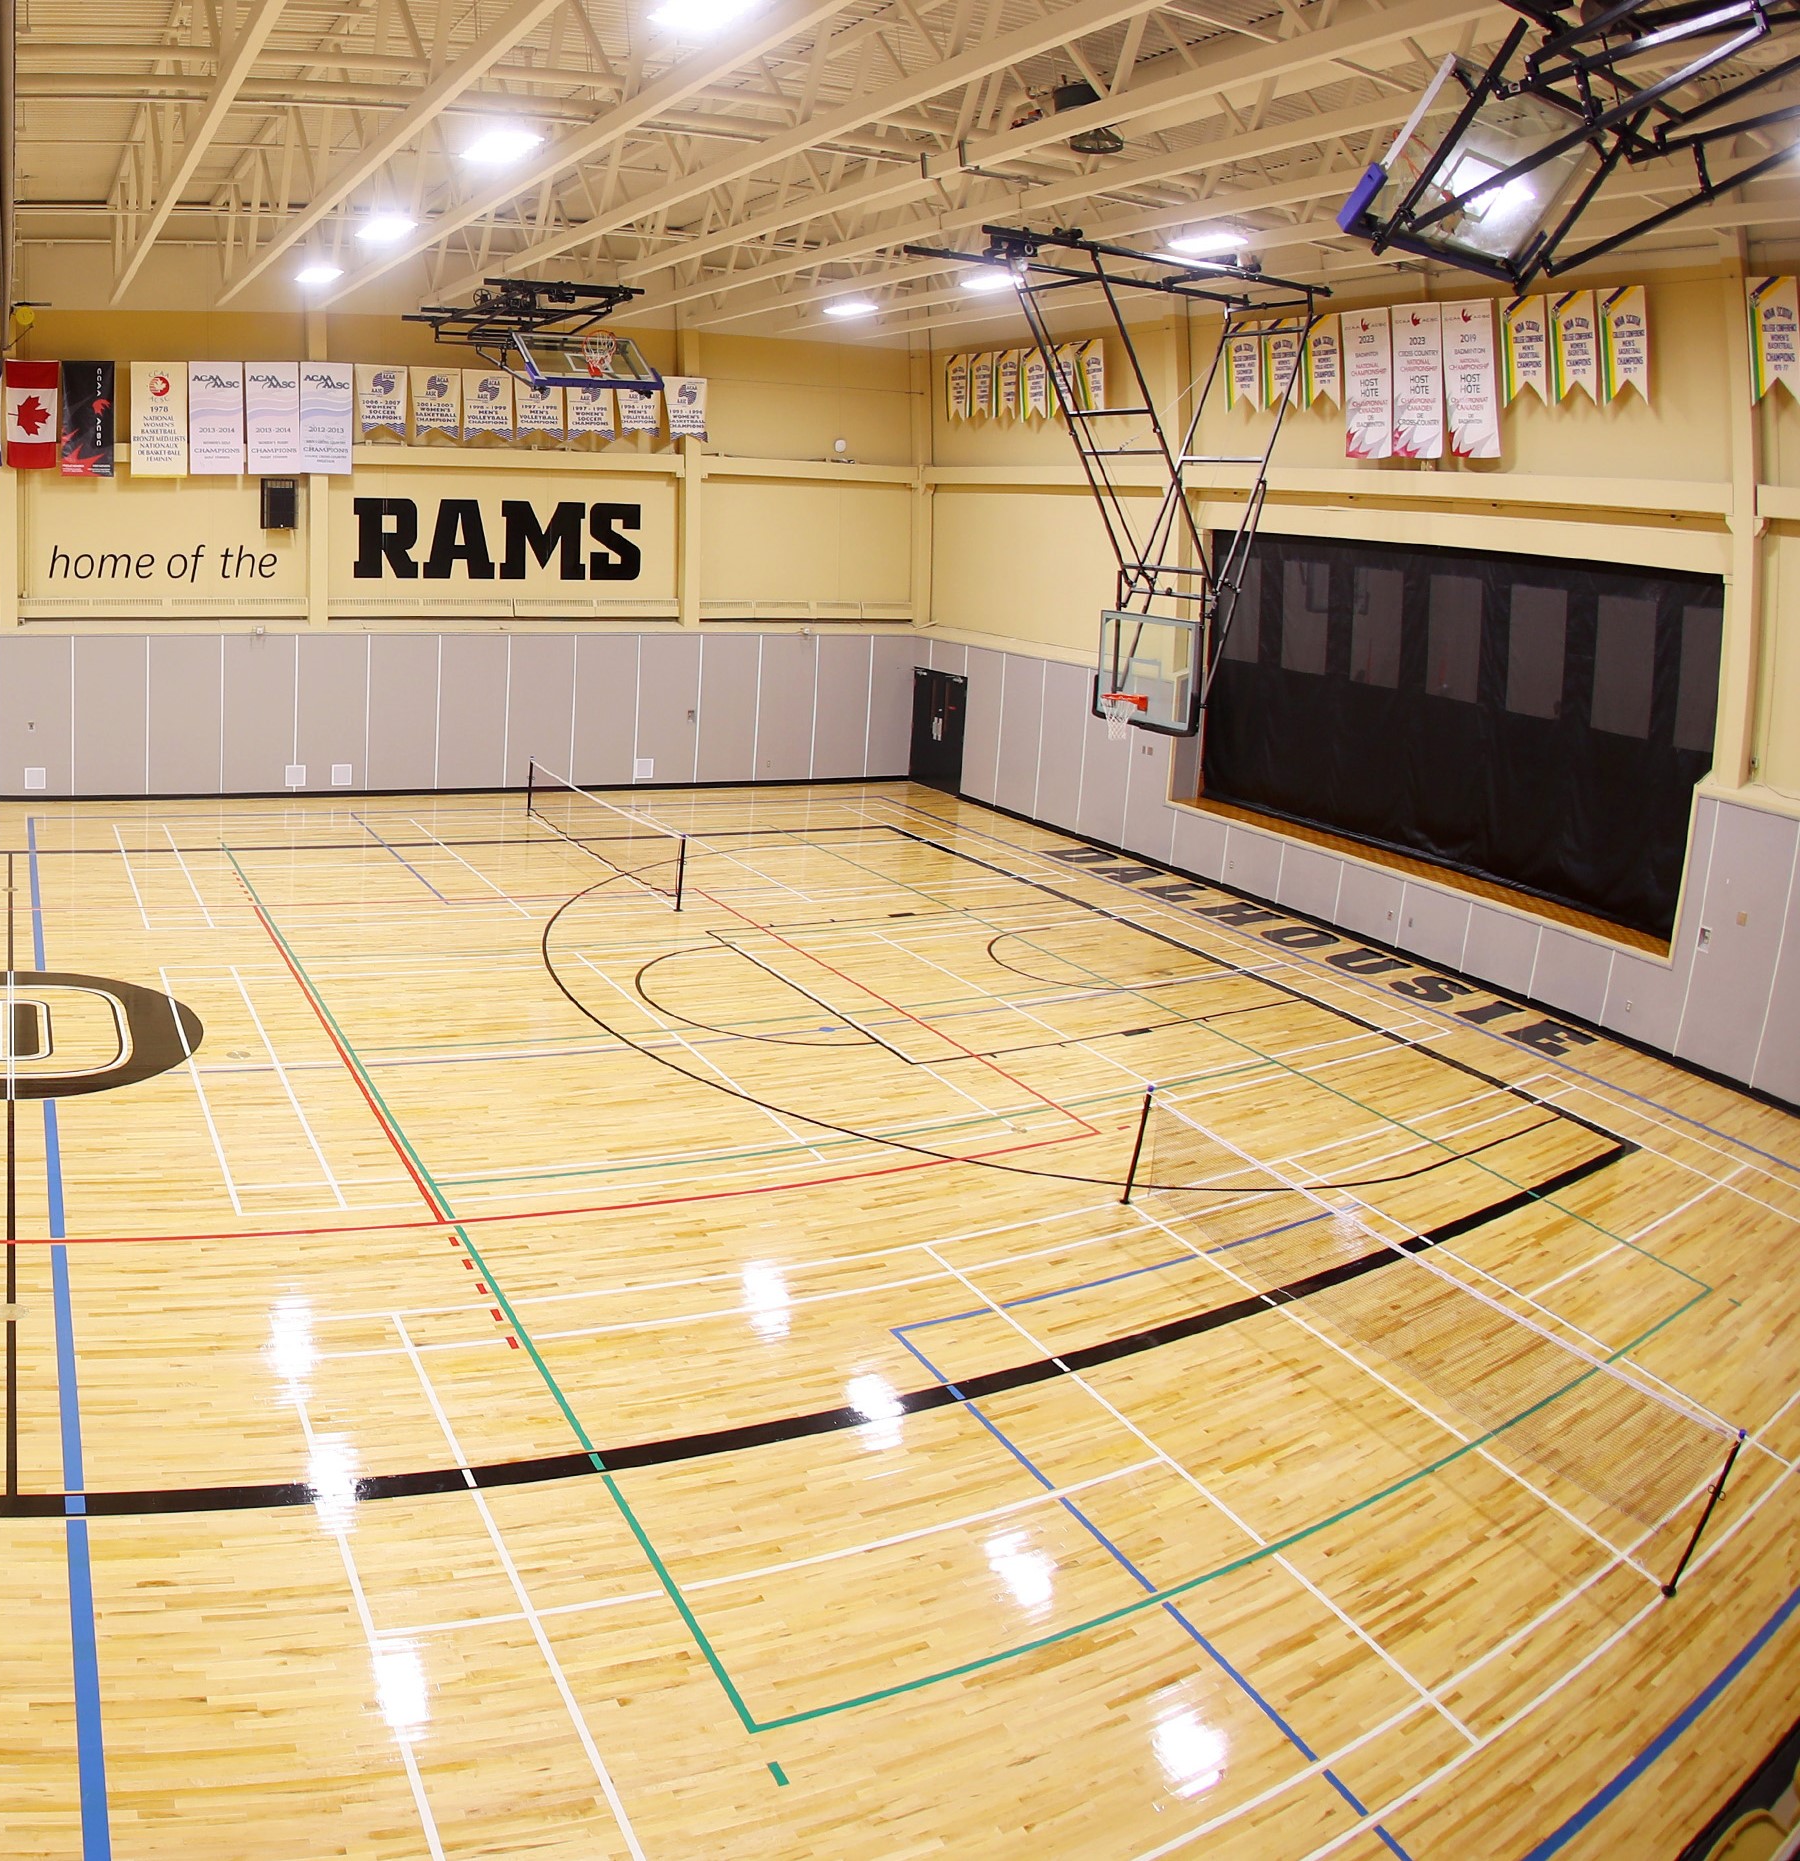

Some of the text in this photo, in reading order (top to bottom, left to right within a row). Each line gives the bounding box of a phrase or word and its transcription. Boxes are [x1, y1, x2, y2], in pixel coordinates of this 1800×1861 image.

[1359, 335, 1375, 344] 2023
[1409, 337, 1425, 345] 2023
[1460, 334, 1476, 342] 2019
[1617, 357, 1643, 365] CHAMPIONS
[1766, 353, 1795, 361] CHAMPIONS
[1360, 378, 1378, 386] HOST
[1410, 375, 1428, 383] HOST
[1460, 374, 1480, 382] HOST
[1361, 387, 1379, 397] HÔTE
[1410, 385, 1429, 394] HÔTE
[1460, 383, 1480, 393] HÔTE
[353, 497, 641, 581] RAMS
[49, 544, 277, 583] home of the
[1040, 846, 1599, 1058] DALHOUSIE
